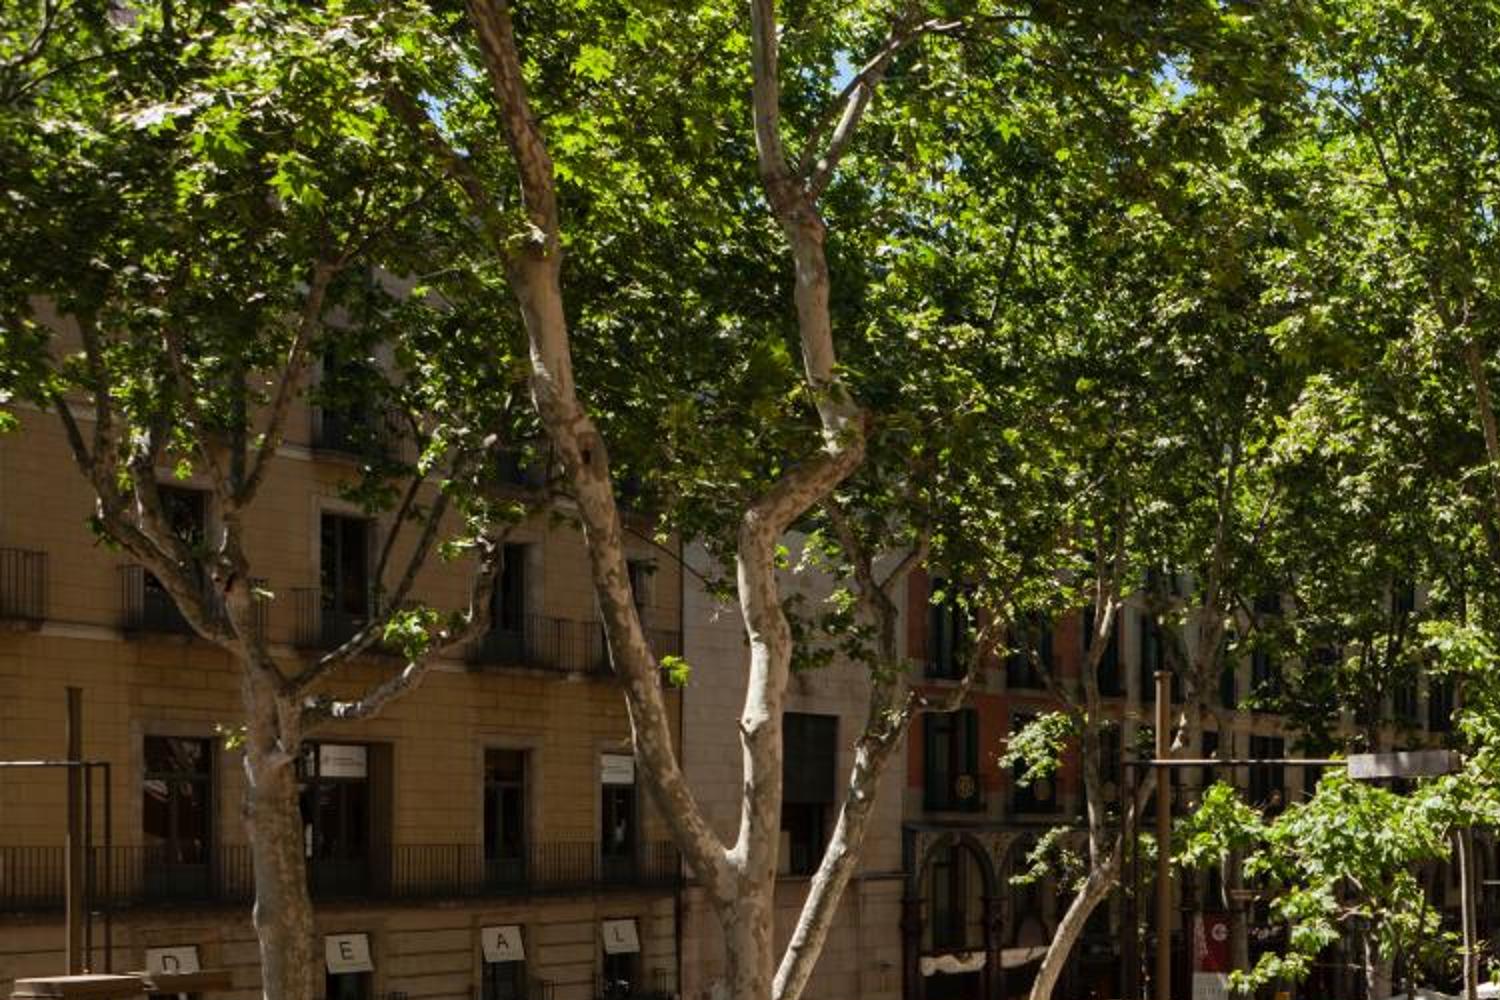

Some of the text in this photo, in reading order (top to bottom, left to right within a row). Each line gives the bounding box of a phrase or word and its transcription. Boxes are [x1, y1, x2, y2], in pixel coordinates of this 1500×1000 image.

[497, 933, 509, 950] A
[613, 927, 625, 943] L
[339, 941, 354, 960] E
